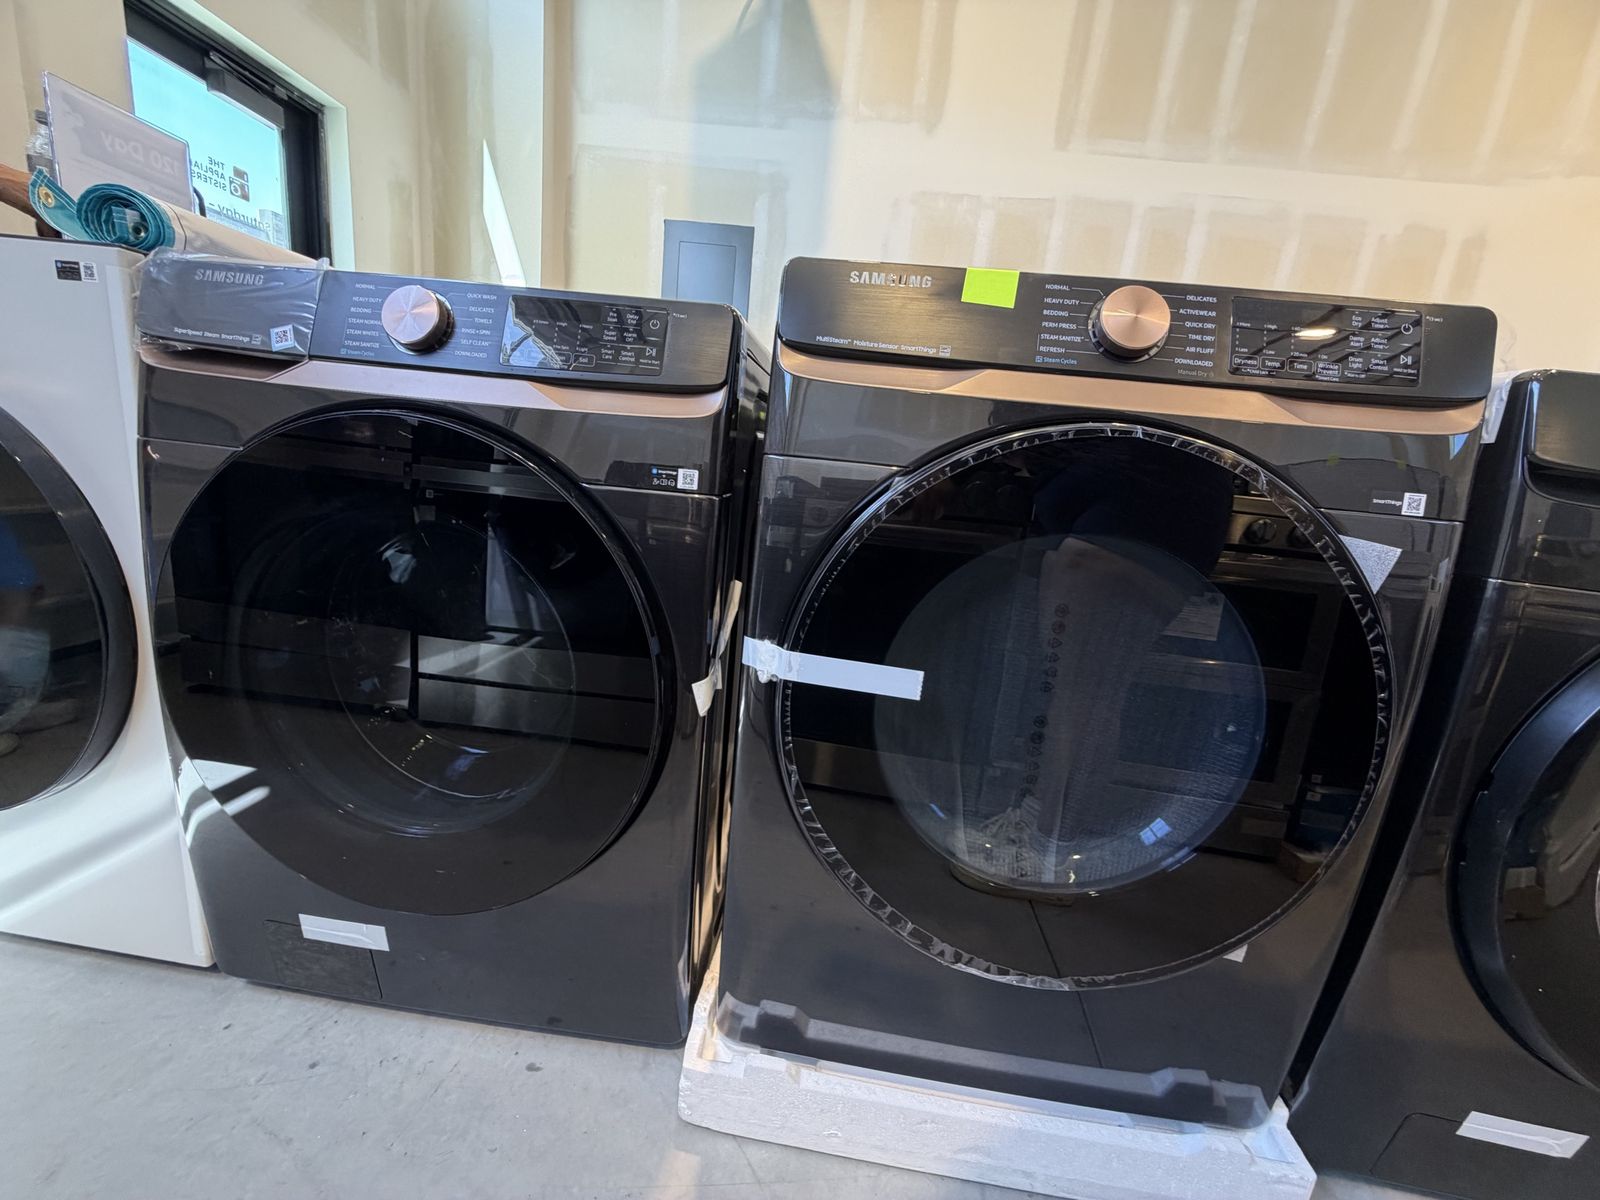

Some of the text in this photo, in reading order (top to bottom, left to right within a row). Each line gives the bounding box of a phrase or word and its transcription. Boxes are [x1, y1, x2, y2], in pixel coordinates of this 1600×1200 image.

[194, 268, 264, 286] SAMSUNG
[850, 270, 932, 288] SAMSUNG
[1179, 308, 1216, 317] ACTIVEWEAR
[901, 344, 936, 354] SmartThings
[1175, 358, 1213, 367] DOWNLOADED
[1234, 358, 1257, 366] Dryness
